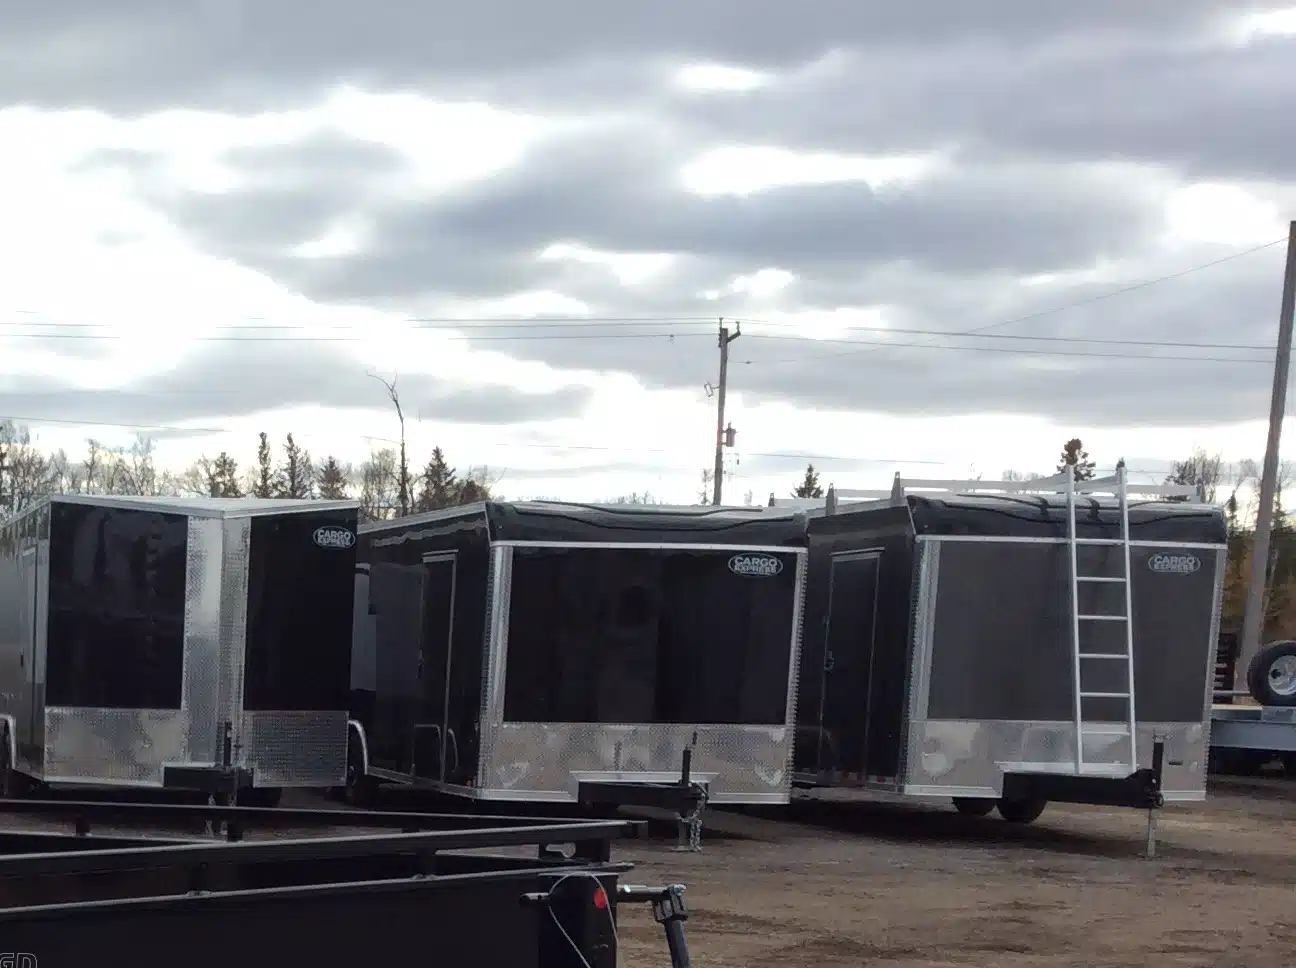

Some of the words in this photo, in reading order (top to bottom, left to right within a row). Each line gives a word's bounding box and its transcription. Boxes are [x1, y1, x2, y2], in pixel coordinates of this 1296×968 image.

[317, 529, 352, 540] CARGO
[734, 557, 778, 567] CARGO
[1154, 556, 1195, 565] CARGO
